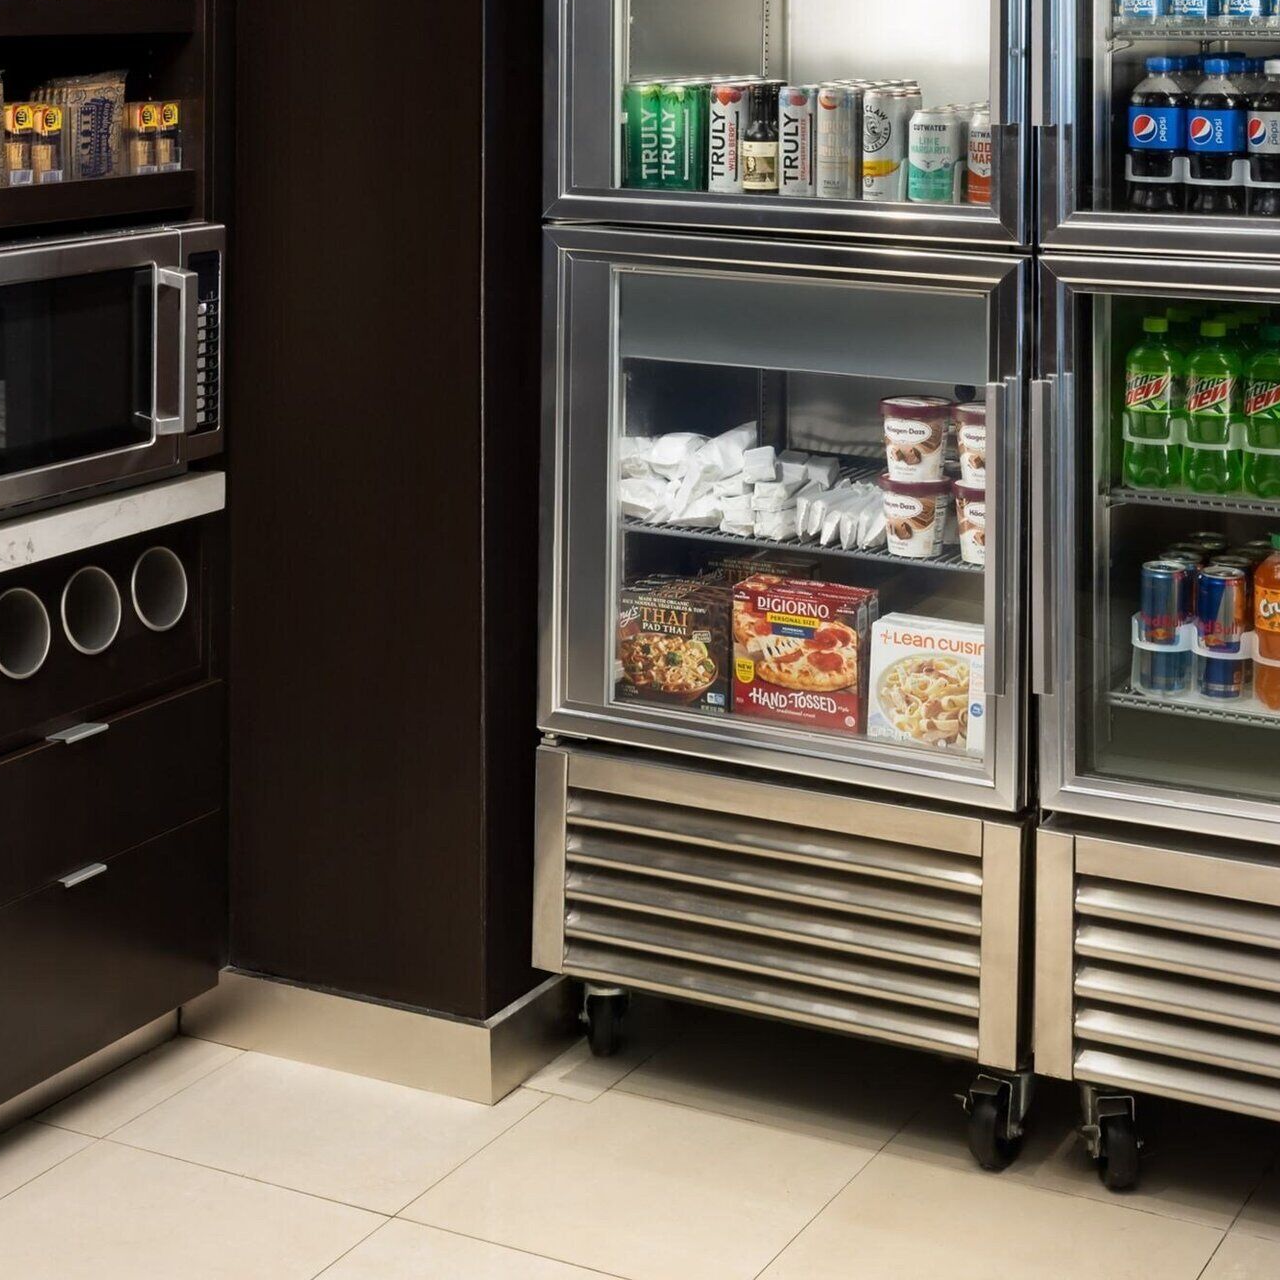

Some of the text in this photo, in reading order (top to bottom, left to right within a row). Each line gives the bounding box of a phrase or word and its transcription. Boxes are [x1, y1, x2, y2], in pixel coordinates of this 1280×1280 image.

[642, 108, 658, 179] TRULY
[662, 109, 676, 180] TRULY
[711, 111, 725, 181] TRULY
[783, 113, 799, 185] TRULY
[1159, 116, 1167, 142] pepsi
[1215, 118, 1223, 144] pepsi
[640, 606, 688, 628] THAI
[643, 622, 686, 635] PAD THAI
